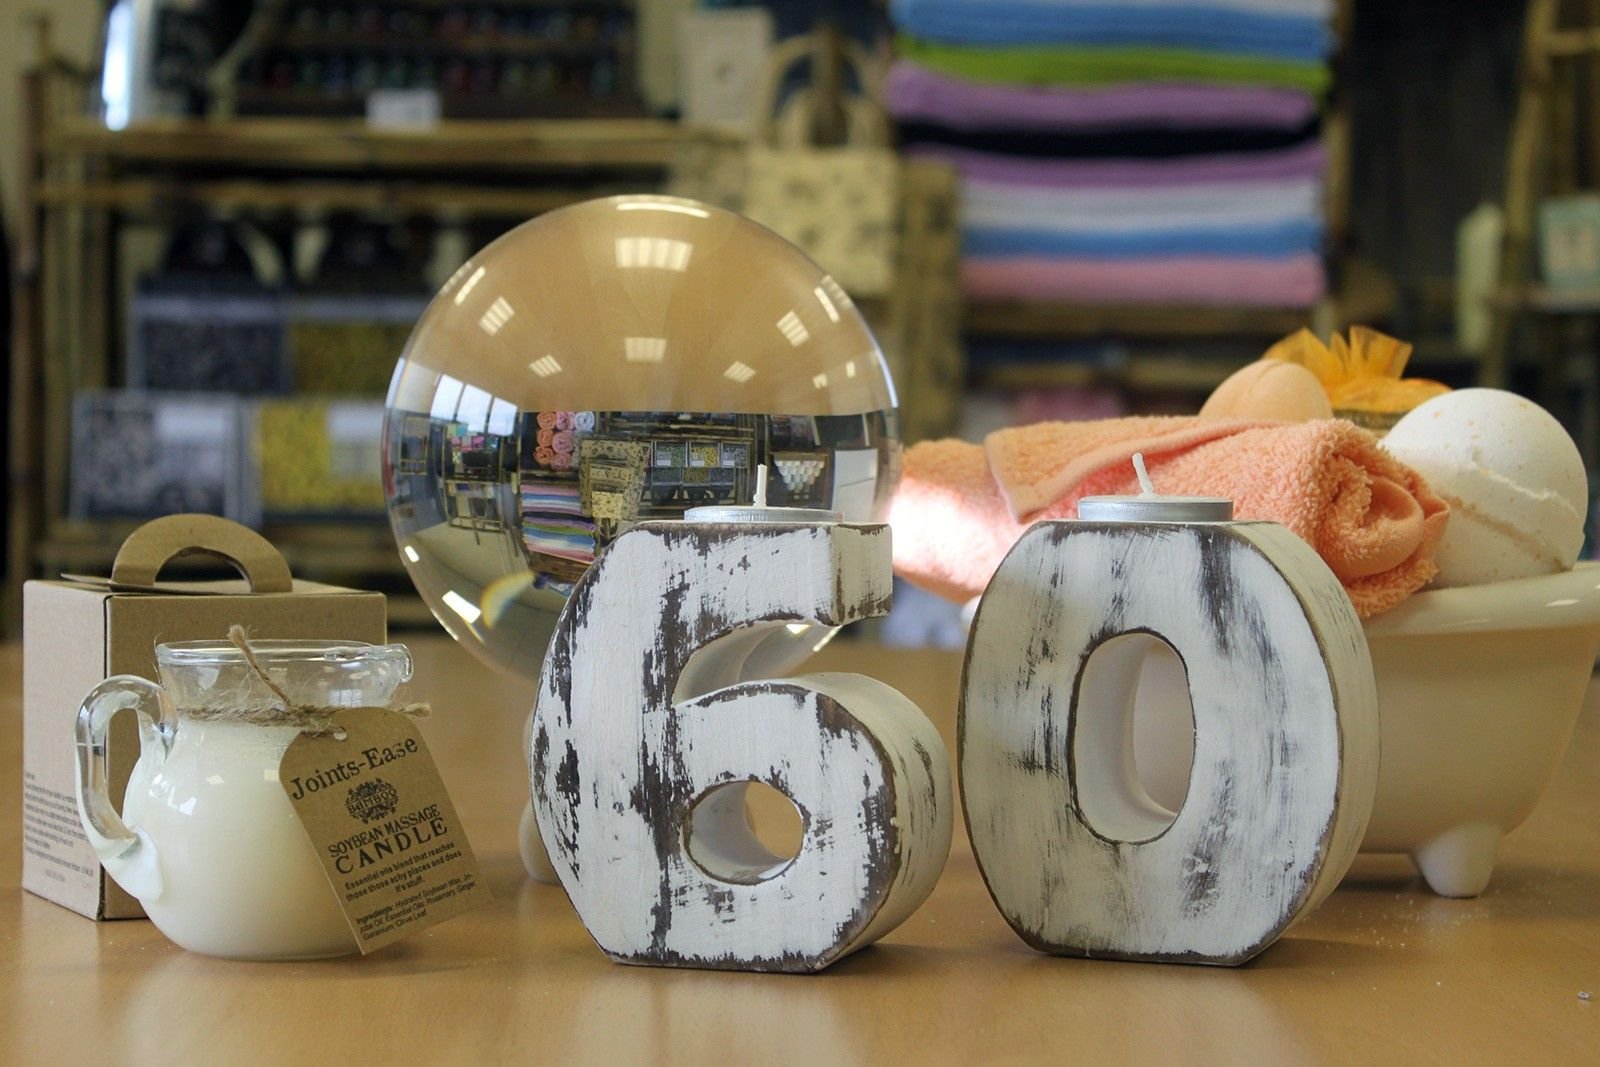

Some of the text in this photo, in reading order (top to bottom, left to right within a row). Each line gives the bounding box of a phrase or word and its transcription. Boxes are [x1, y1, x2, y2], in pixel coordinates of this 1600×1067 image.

[290, 737, 419, 801] Joints-Ease
[346, 786, 397, 814] BAMBOO
[327, 803, 441, 858] SOYBEAN MASSAGE
[334, 817, 448, 875] CANDLE
[344, 870, 378, 890] Essential
[392, 856, 413, 871] blend
[412, 850, 428, 862] that
[426, 840, 455, 857] reaches
[345, 886, 368, 902] those
[367, 878, 389, 893] those
[430, 855, 445, 867] and
[443, 848, 462, 862] does
